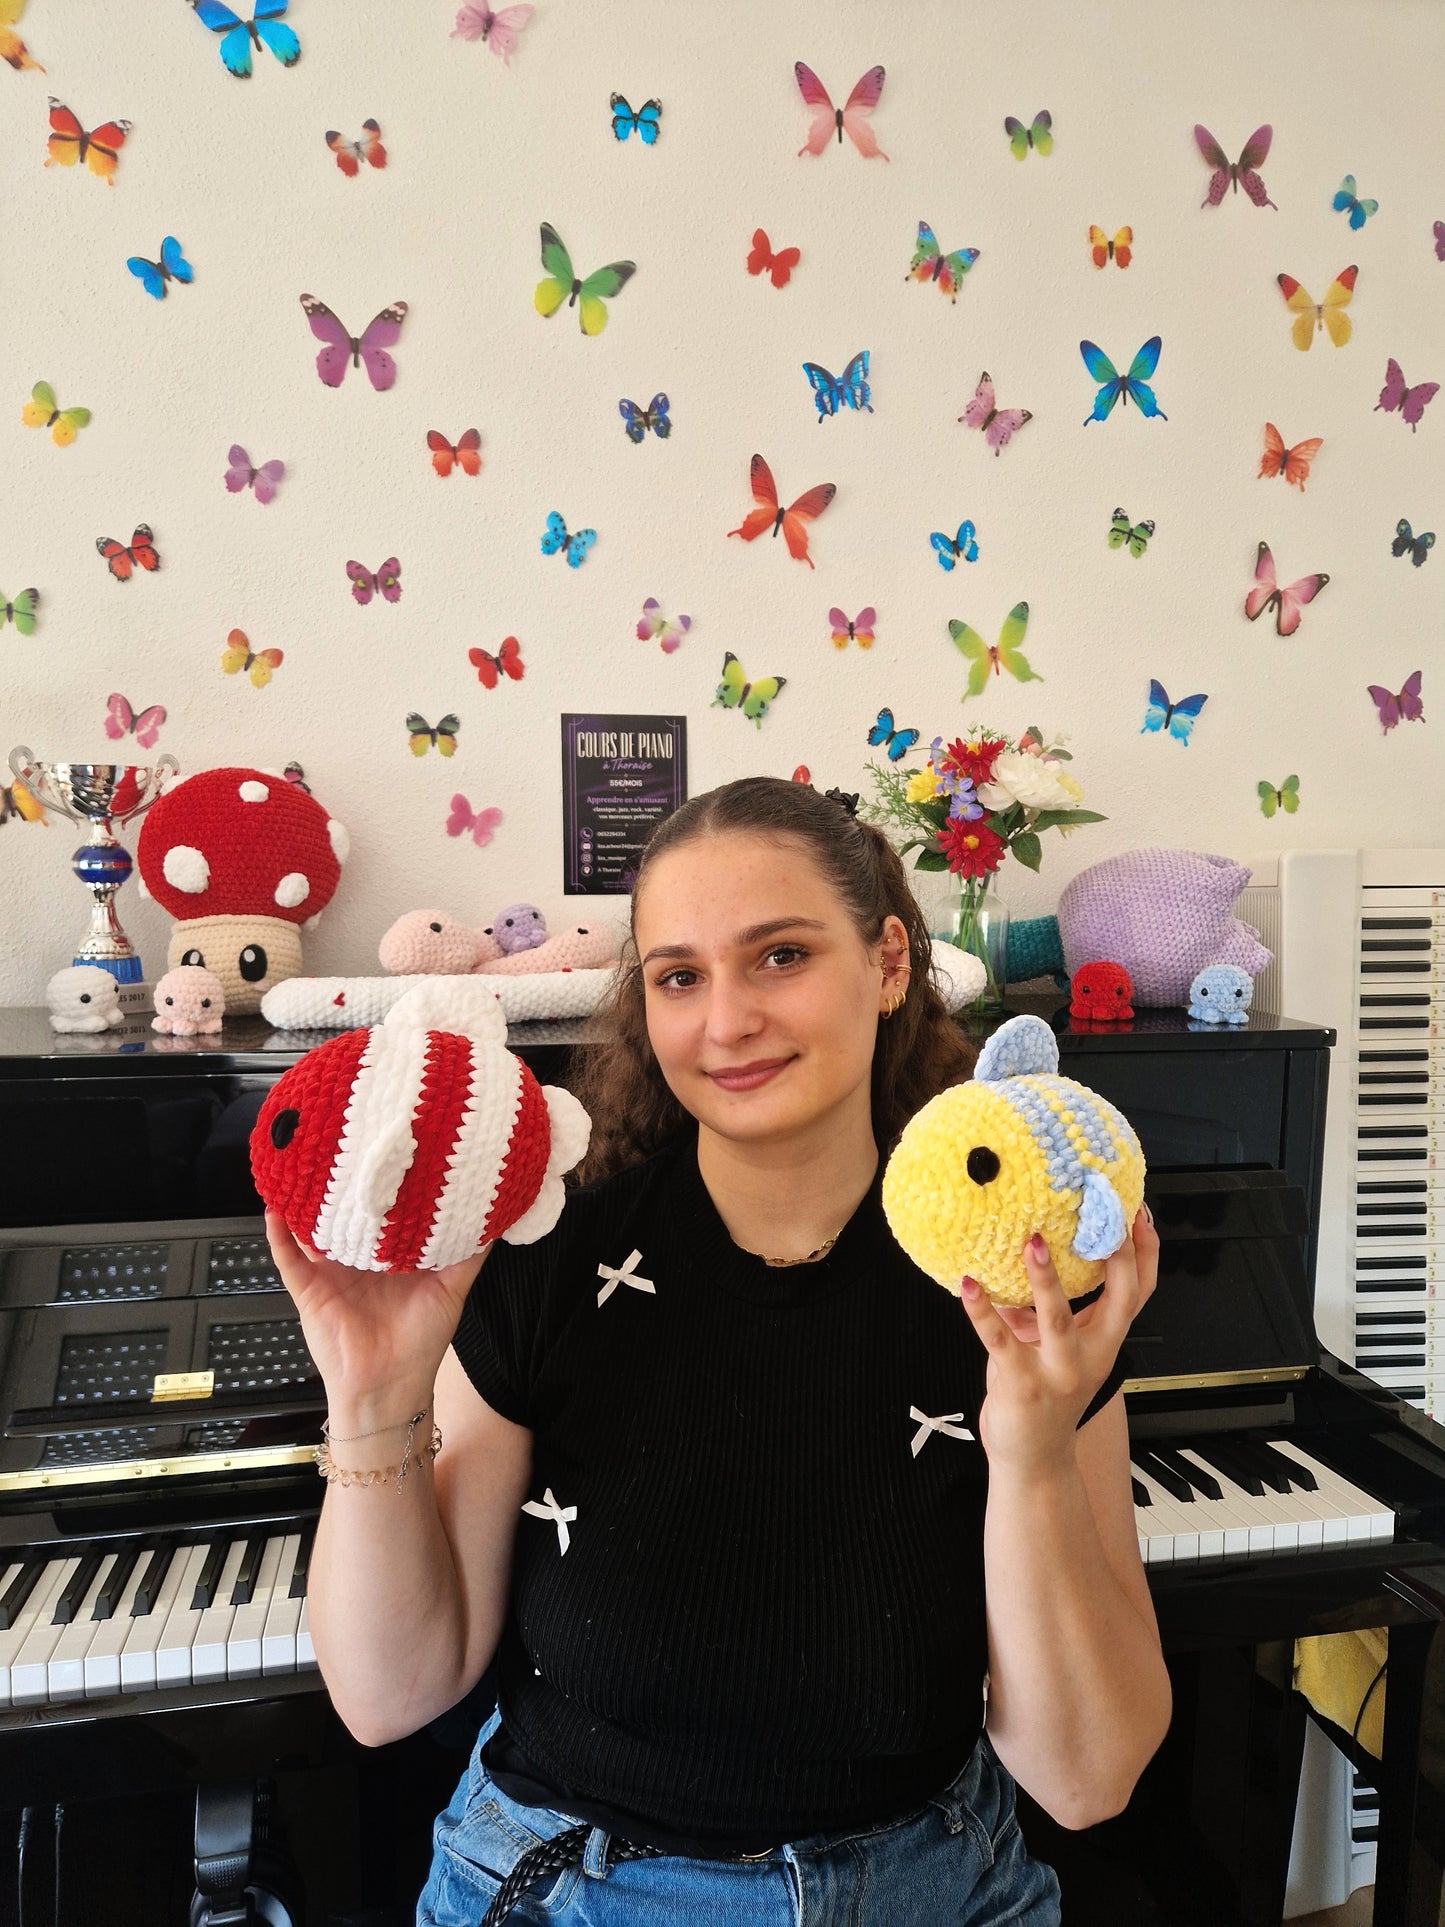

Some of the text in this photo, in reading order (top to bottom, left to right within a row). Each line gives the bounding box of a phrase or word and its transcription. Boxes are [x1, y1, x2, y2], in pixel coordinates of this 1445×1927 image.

[577, 731, 673, 759] COURS DE PIANO
[587, 796, 623, 805] Apprendre
[634, 796, 668, 804] s'amusant
[129, 992, 145, 1002] 2017
